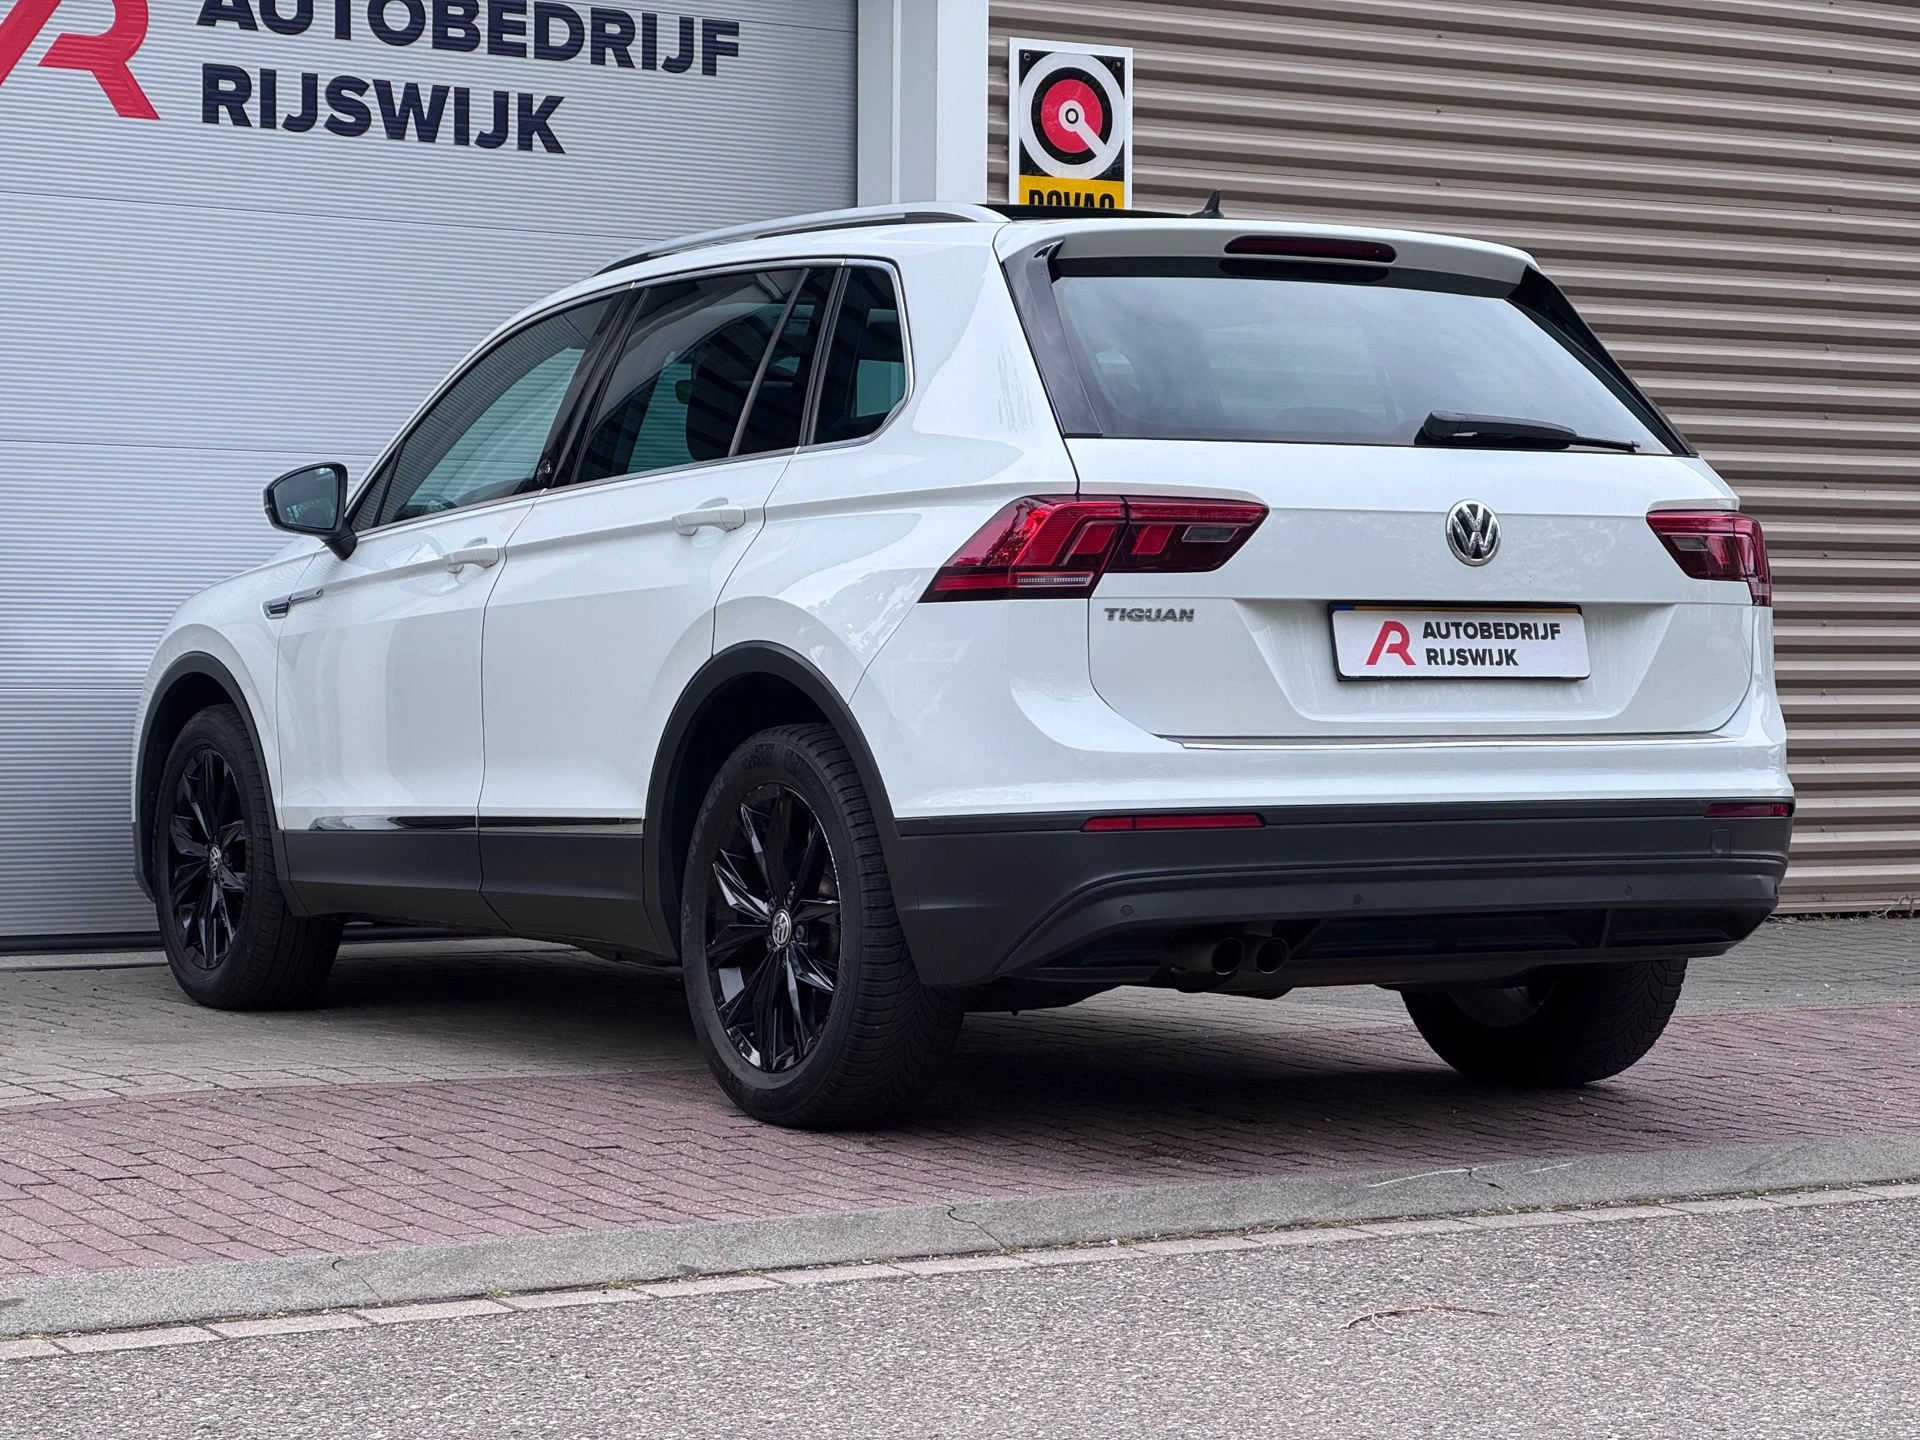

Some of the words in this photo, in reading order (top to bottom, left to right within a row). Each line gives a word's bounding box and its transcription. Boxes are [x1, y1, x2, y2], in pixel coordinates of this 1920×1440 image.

[201, 62, 567, 155] RIJSWIJK
[1103, 607, 1195, 622] TIGUAN
[1422, 621, 1561, 640] AUTOBEDRIJF
[1425, 648, 1519, 666] RIJSWIJK
